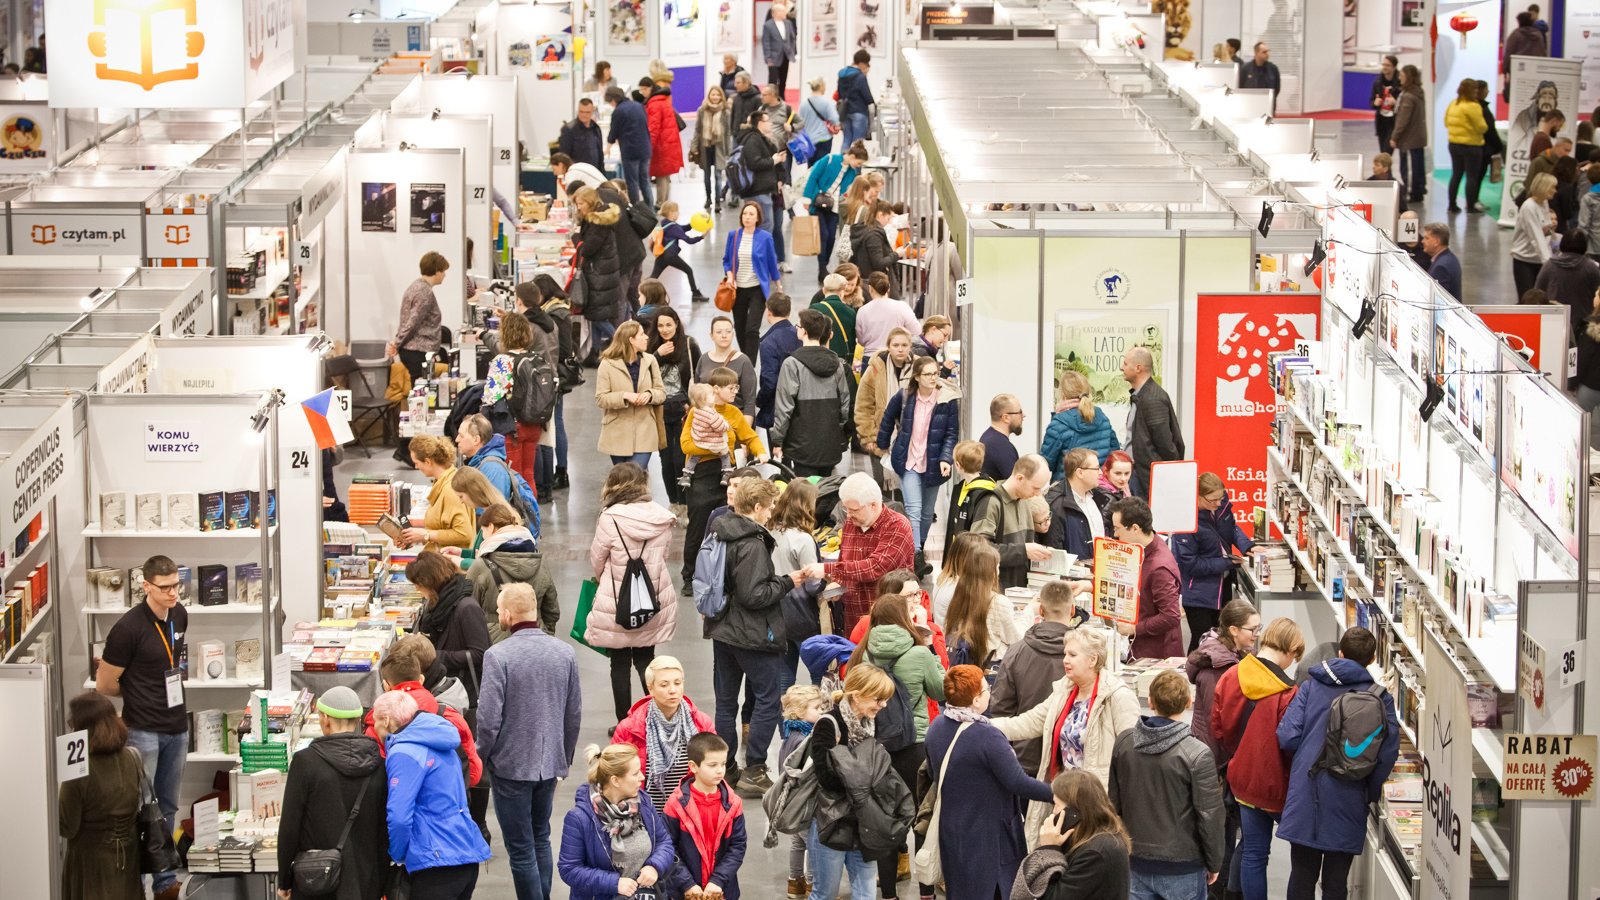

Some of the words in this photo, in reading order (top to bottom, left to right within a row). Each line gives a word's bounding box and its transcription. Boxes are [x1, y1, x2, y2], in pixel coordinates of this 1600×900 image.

[500, 149, 511, 160] 28
[473, 187, 485, 199] 27
[61, 228, 126, 243] czytam.pl
[1404, 221, 1416, 235] 44
[300, 245, 310, 259] 26
[958, 283, 967, 298] 35
[1093, 336, 1125, 353] LATO
[1297, 343, 1309, 357] 36
[183, 379, 215, 388] NAJLEPIEJ
[157, 431, 190, 440] KOMU
[147, 441, 200, 452] WIERZYĆ?
[15, 425, 60, 489] COPERNICUS
[291, 450, 309, 469] 24
[12, 475, 42, 524] CENTER
[42, 452, 64, 493] PRESS
[630, 611, 655, 628] BTS
[1521, 633, 1540, 665] RABAT
[1562, 649, 1576, 675] 36
[67, 738, 85, 766] 22
[1507, 736, 1573, 755] RABAT
[1506, 763, 1519, 774] NA
[1522, 762, 1547, 778] CAŁĄ
[1555, 766, 1588, 788] -30%
[1506, 778, 1546, 793] OFERTĘ
